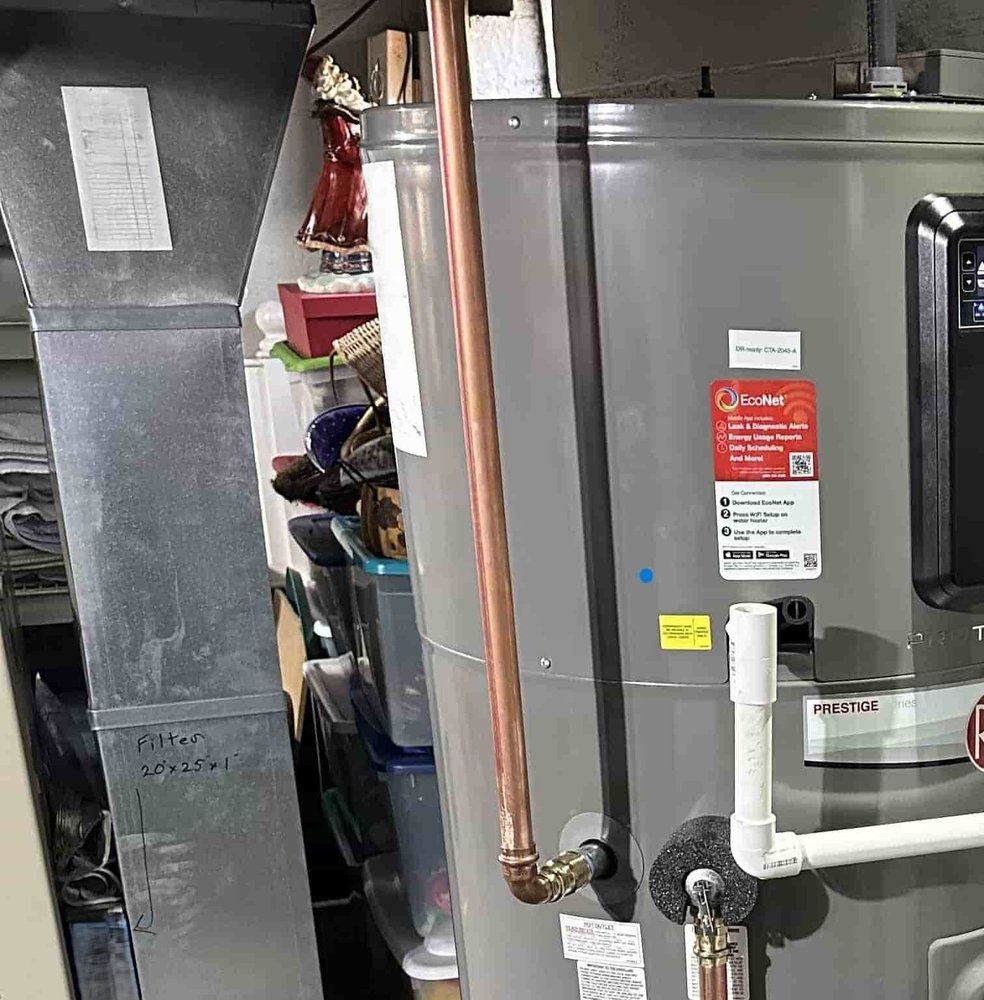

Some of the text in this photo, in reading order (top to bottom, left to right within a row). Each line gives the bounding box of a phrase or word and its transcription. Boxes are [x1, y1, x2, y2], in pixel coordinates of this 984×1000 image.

[740, 394, 785, 407] EcoNet
[752, 423, 787, 431] Diagnostic
[728, 434, 802, 442] Energy Usage Reports
[813, 700, 879, 716] PRESTIGE
[137, 732, 205, 752] Filter
